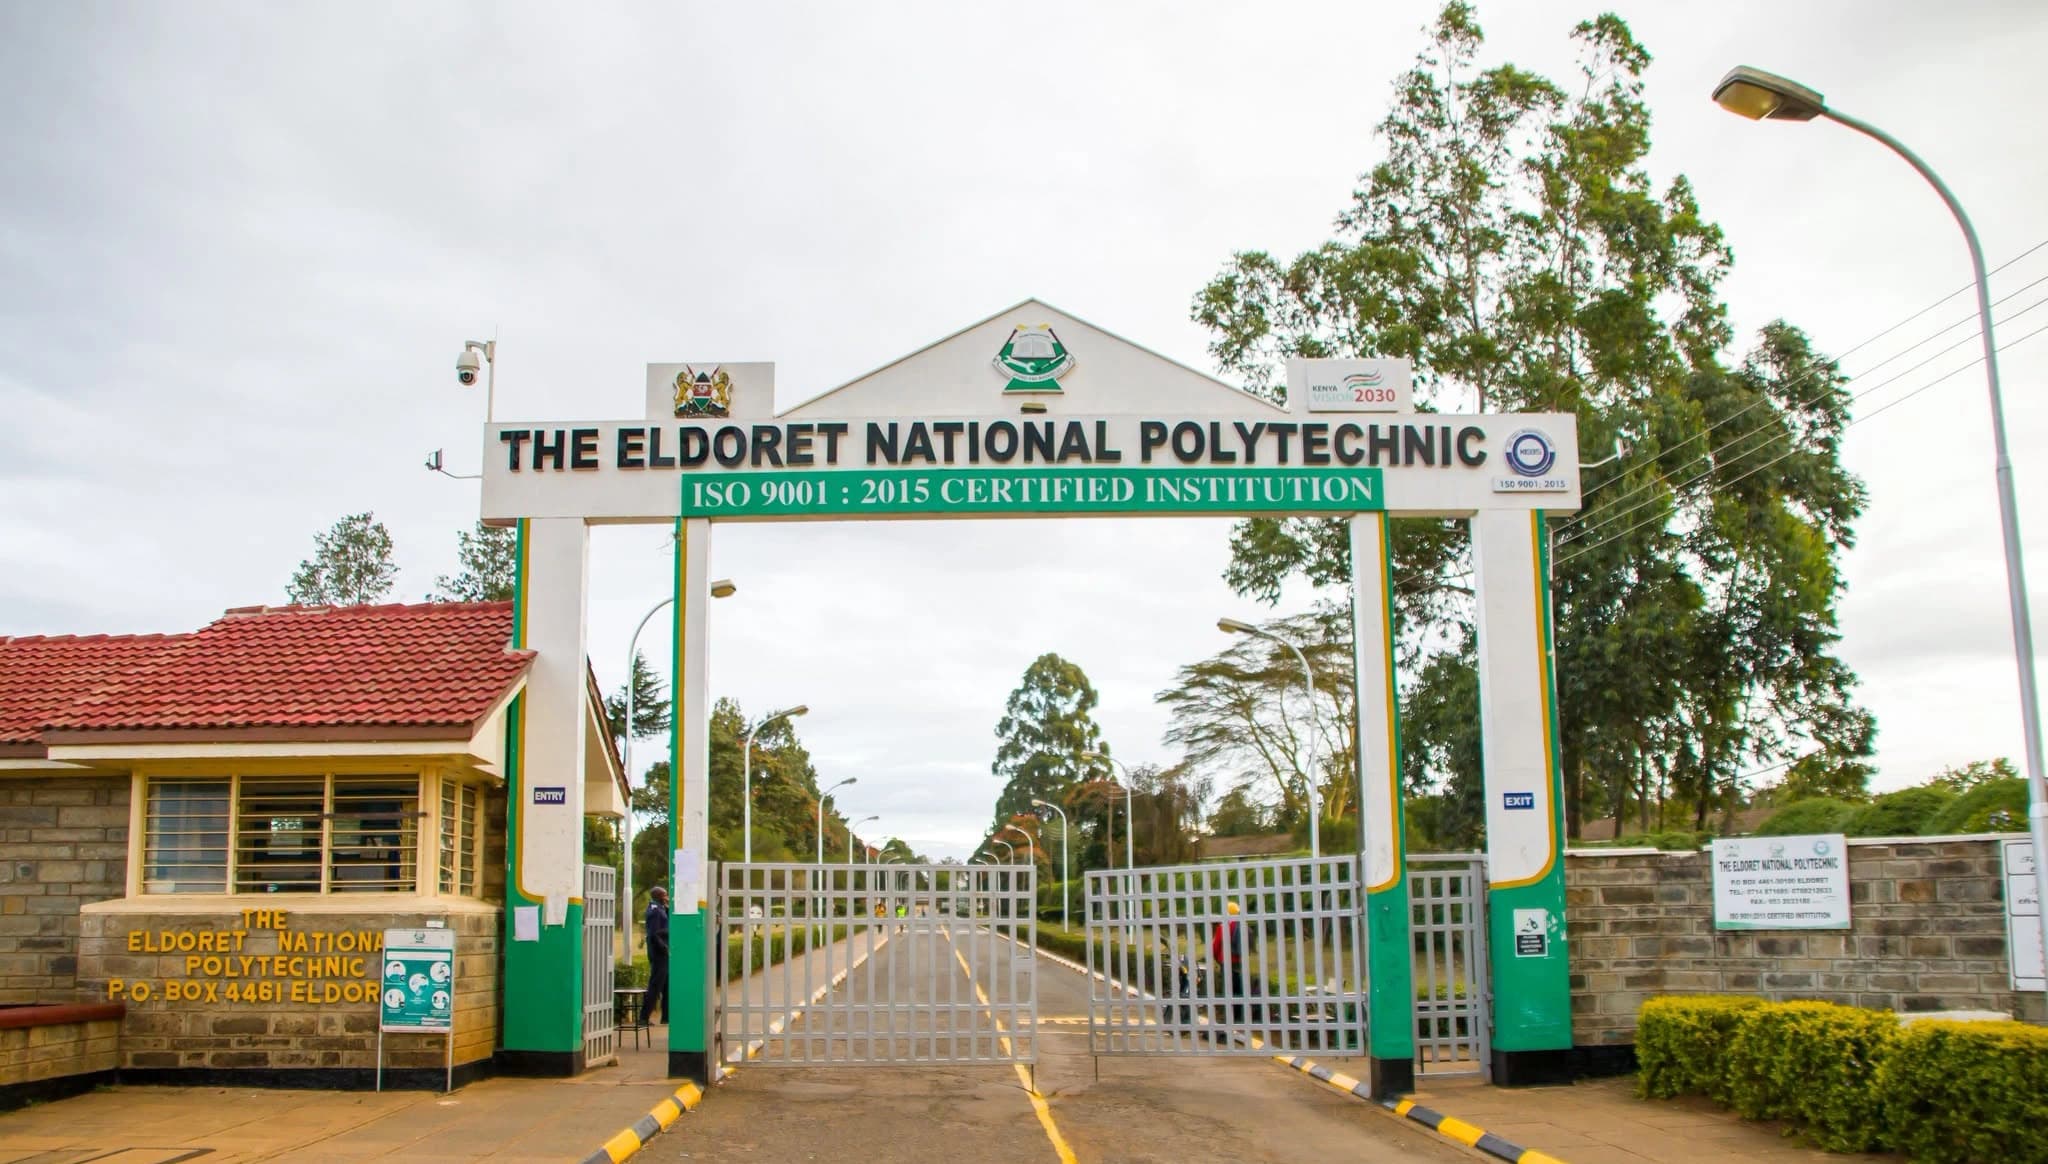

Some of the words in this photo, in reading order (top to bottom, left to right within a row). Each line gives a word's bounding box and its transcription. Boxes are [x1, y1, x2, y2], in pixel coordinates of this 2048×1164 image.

[1313, 393, 1354, 402] VISION
[1355, 389, 1396, 402] 2030
[500, 429, 599, 471] THE
[617, 423, 848, 469] ELDORET
[866, 421, 1122, 465] NATIONAL
[1140, 421, 1488, 467] POLYTECHNIC
[693, 481, 751, 507] ISO
[761, 480, 828, 505] 9001
[860, 478, 930, 504] 2015
[941, 477, 1134, 503] CERTIFIED
[1146, 477, 1373, 502] INSTITUTION
[535, 792, 564, 801] ENTRY
[1506, 797, 1532, 806] EXIT
[1720, 861, 1731, 872] THE
[1733, 860, 1760, 871] ELDORET
[1762, 859, 1793, 871] NATIONAL
[1794, 857, 1839, 870] POLYTECHNIC
[242, 909, 288, 930] THE
[127, 931, 247, 952] ELDORET
[278, 931, 384, 952] NATIONA
[185, 955, 366, 979] POLYTECHNIC
[108, 978, 158, 1002] P.O.
[165, 981, 218, 1003] BOX
[225, 981, 282, 1003] 4461
[290, 981, 380, 1003] ELDOR
